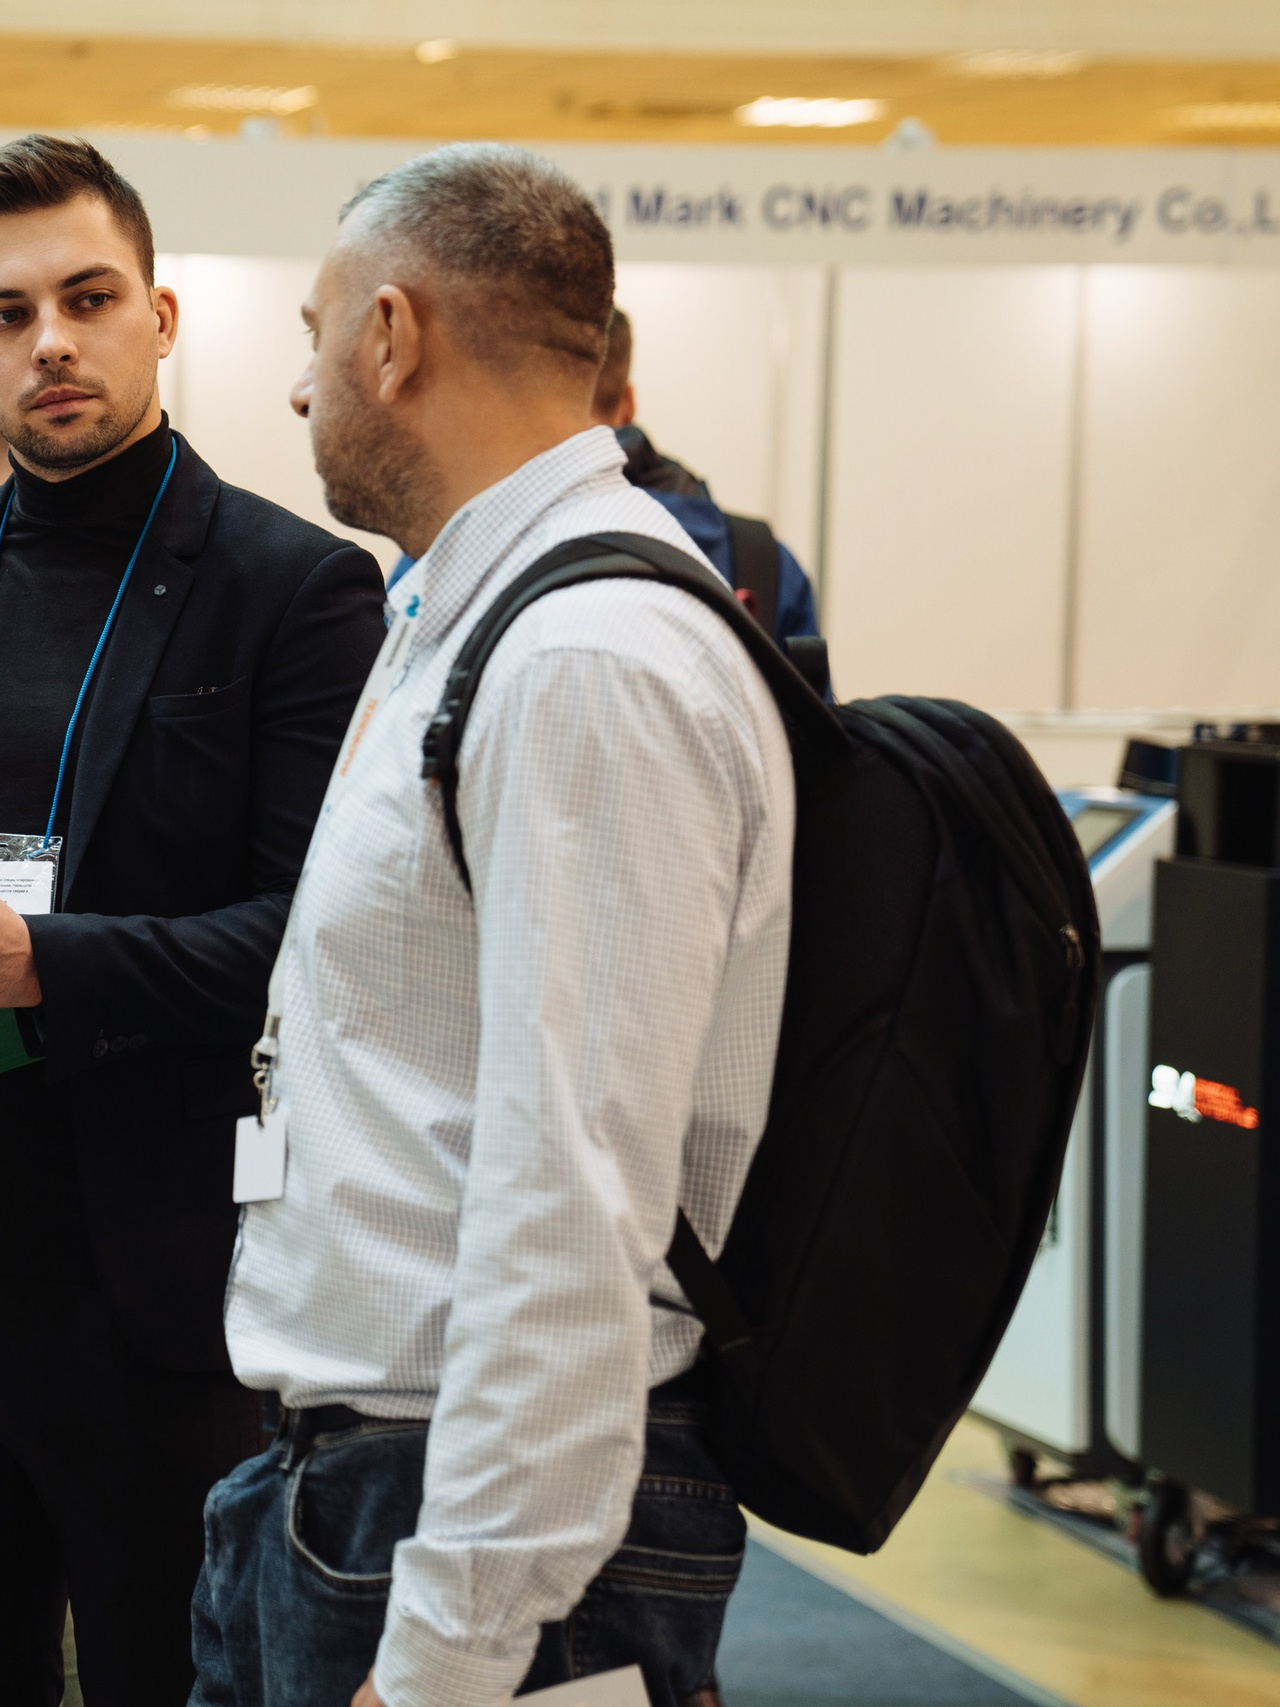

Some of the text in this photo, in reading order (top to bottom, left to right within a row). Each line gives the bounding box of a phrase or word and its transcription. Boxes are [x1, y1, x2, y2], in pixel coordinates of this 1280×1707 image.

[625, 183, 742, 227] Mark
[761, 183, 871, 232] CNC
[887, 184, 1142, 243] Machinery
